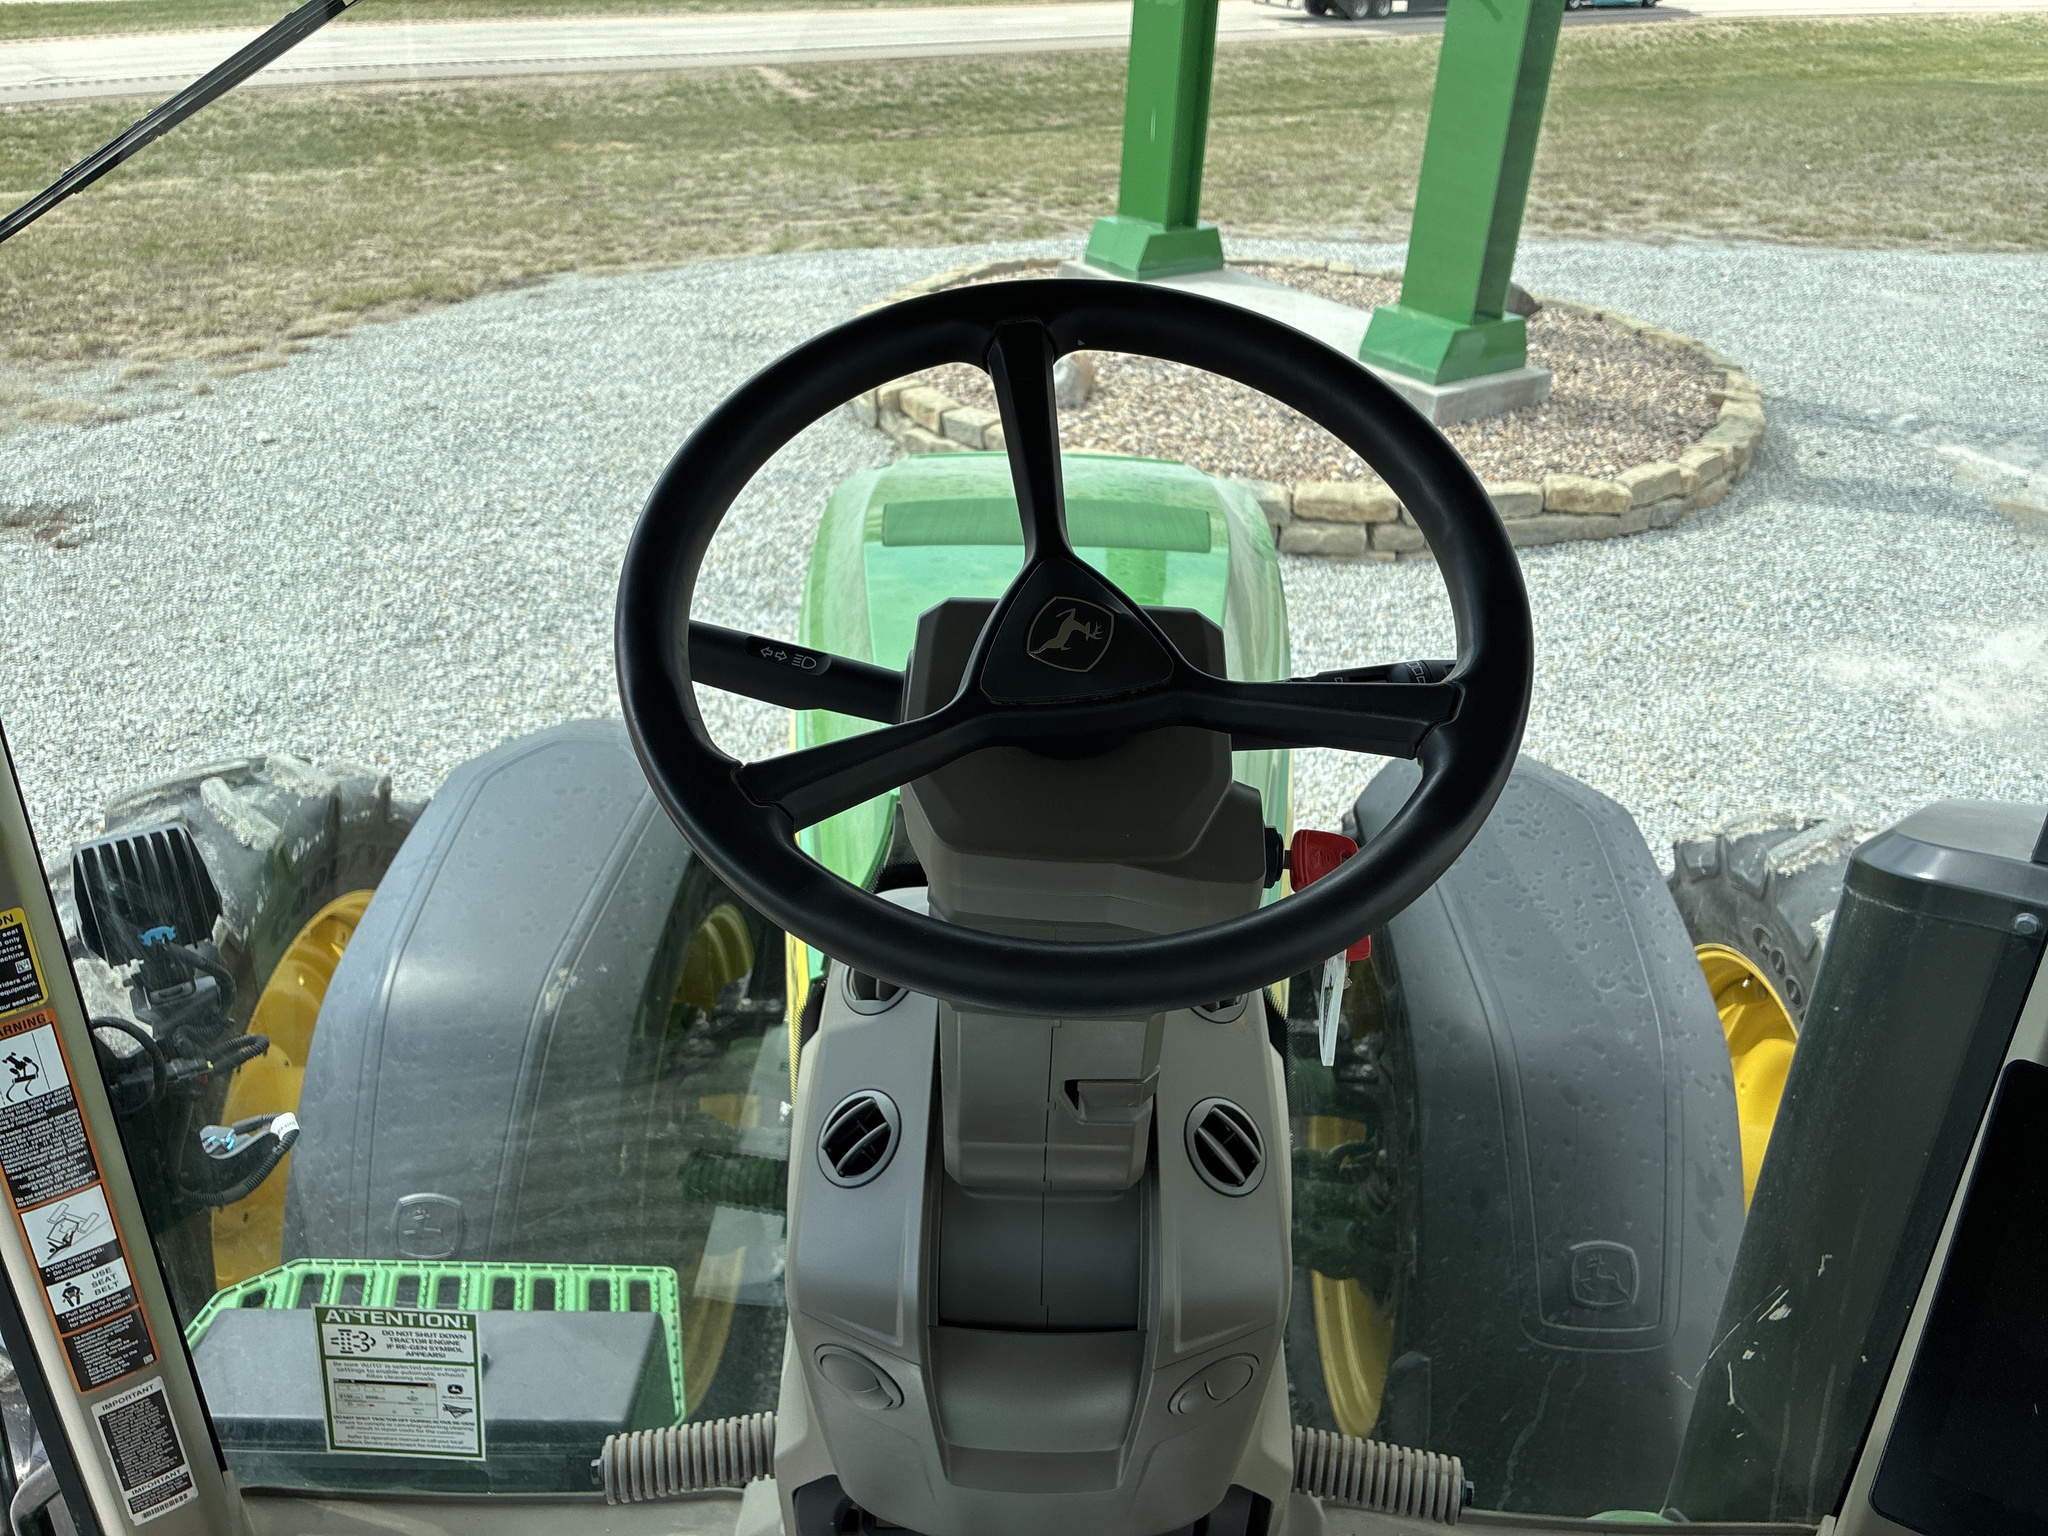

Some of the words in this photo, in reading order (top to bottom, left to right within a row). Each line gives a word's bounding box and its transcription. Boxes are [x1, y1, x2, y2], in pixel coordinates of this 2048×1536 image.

[3, 935, 21, 946] only
[44, 1260, 66, 1273] AVOID
[52, 1268, 62, 1276] Do
[63, 1264, 74, 1272] not
[74, 1257, 92, 1269] jump
[53, 1267, 82, 1281] machine
[81, 1260, 97, 1271] tips.
[91, 1266, 112, 1279] USE
[90, 1272, 118, 1288] SEAT
[93, 1280, 120, 1296] BELT
[65, 1309, 78, 1318] Pull
[78, 1305, 91, 1313] belt
[91, 1298, 106, 1308] fully
[105, 1292, 121, 1302] from
[67, 1307, 98, 1323] retractors
[98, 1302, 111, 1311] and
[110, 1293, 131, 1306] adjust
[68, 1320, 79, 1328] for
[79, 1315, 94, 1325] best
[93, 1301, 127, 1319] protection.
[323, 1307, 469, 1328] ATTENTION!
[388, 1336, 427, 1344] TRACTOR
[428, 1338, 460, 1346] ENGINE
[395, 1343, 427, 1351] RE-GEN
[101, 1383, 155, 1411] IMPORTANT
[130, 1468, 181, 1495] IMPORTANT
